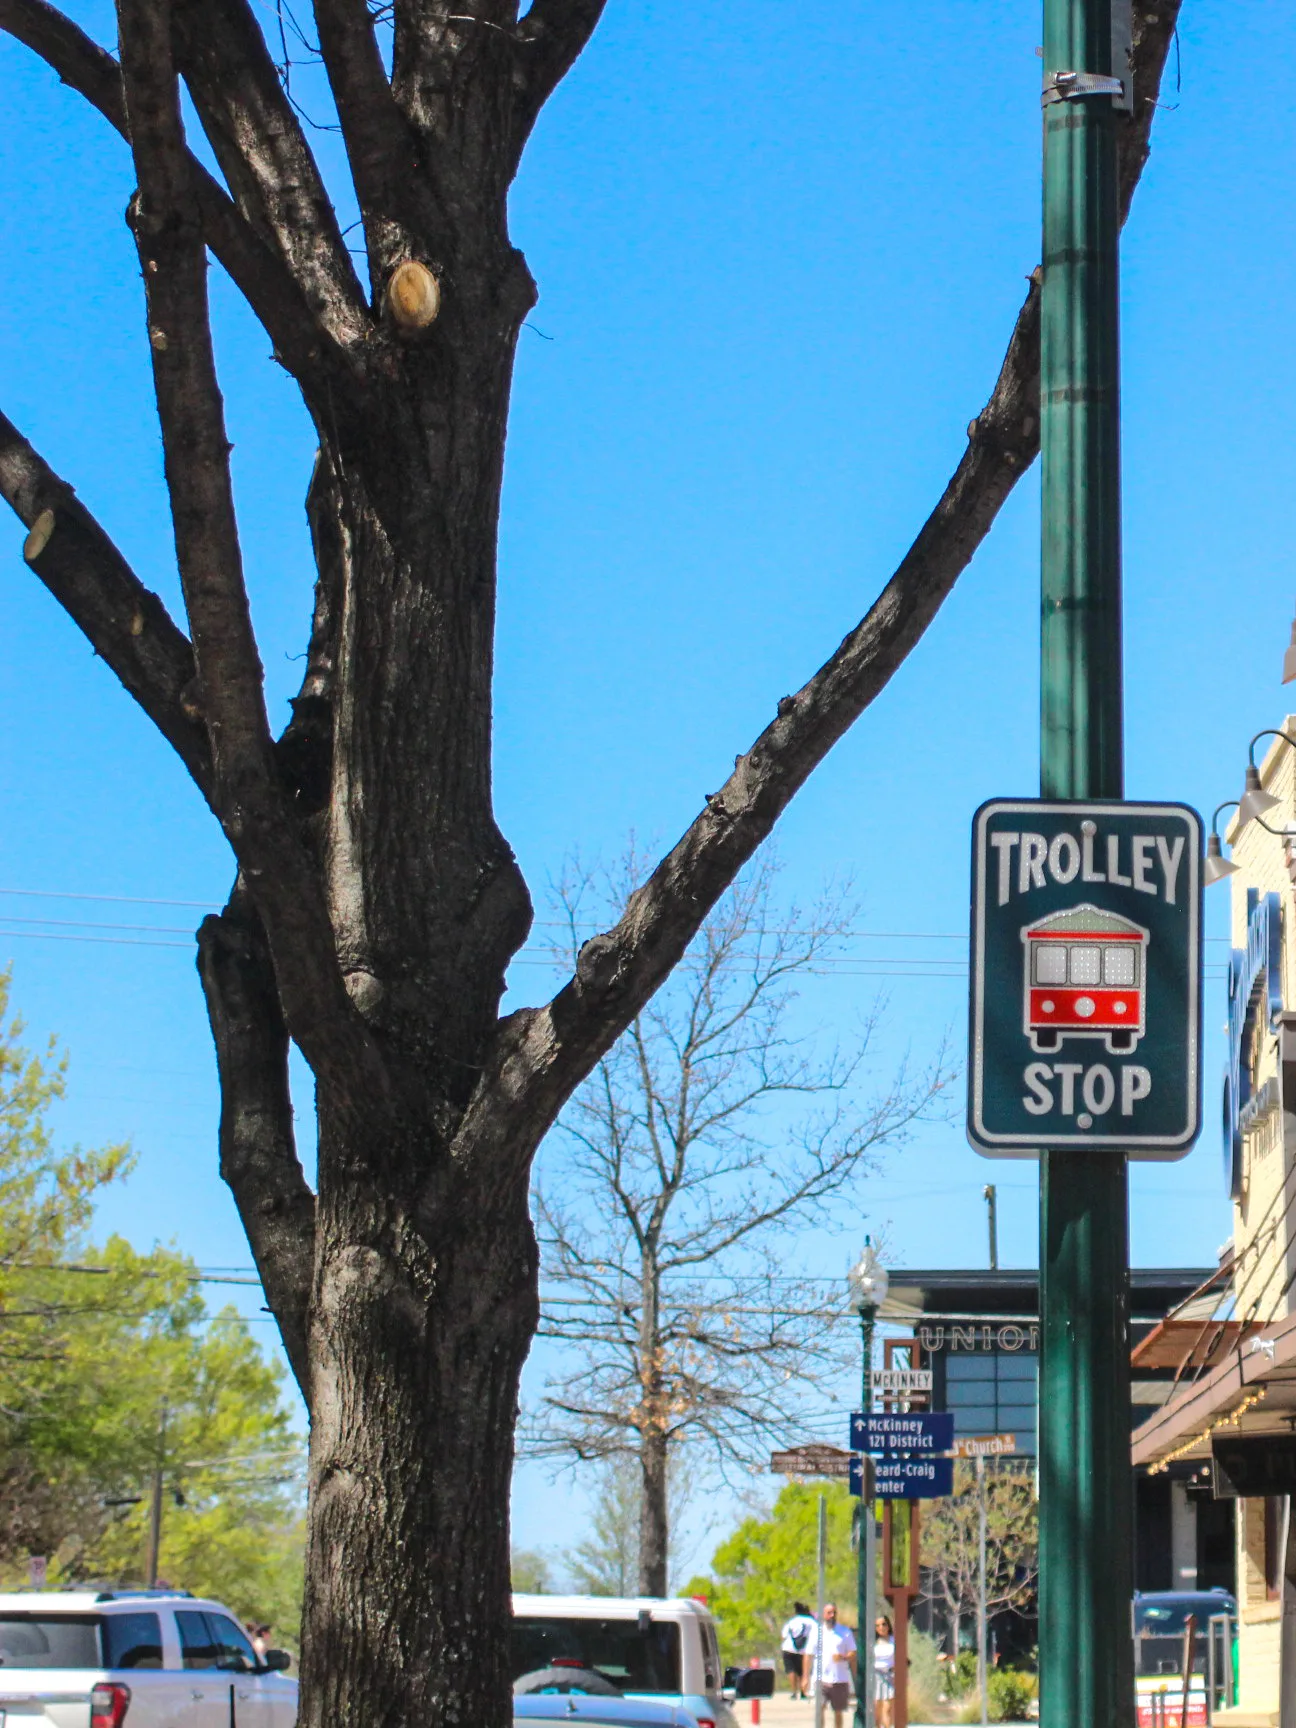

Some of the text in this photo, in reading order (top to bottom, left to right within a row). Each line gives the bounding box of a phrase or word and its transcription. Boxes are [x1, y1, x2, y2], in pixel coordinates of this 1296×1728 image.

[990, 831, 1186, 906] TROLLEY
[1022, 1061, 1152, 1117] STOP
[868, 1419, 923, 1435] McKinney
[869, 1434, 933, 1447] 121 District
[965, 1436, 1003, 1456] Church
[875, 1463, 935, 1480] eard-Craig
[875, 1481, 905, 1493] enter
